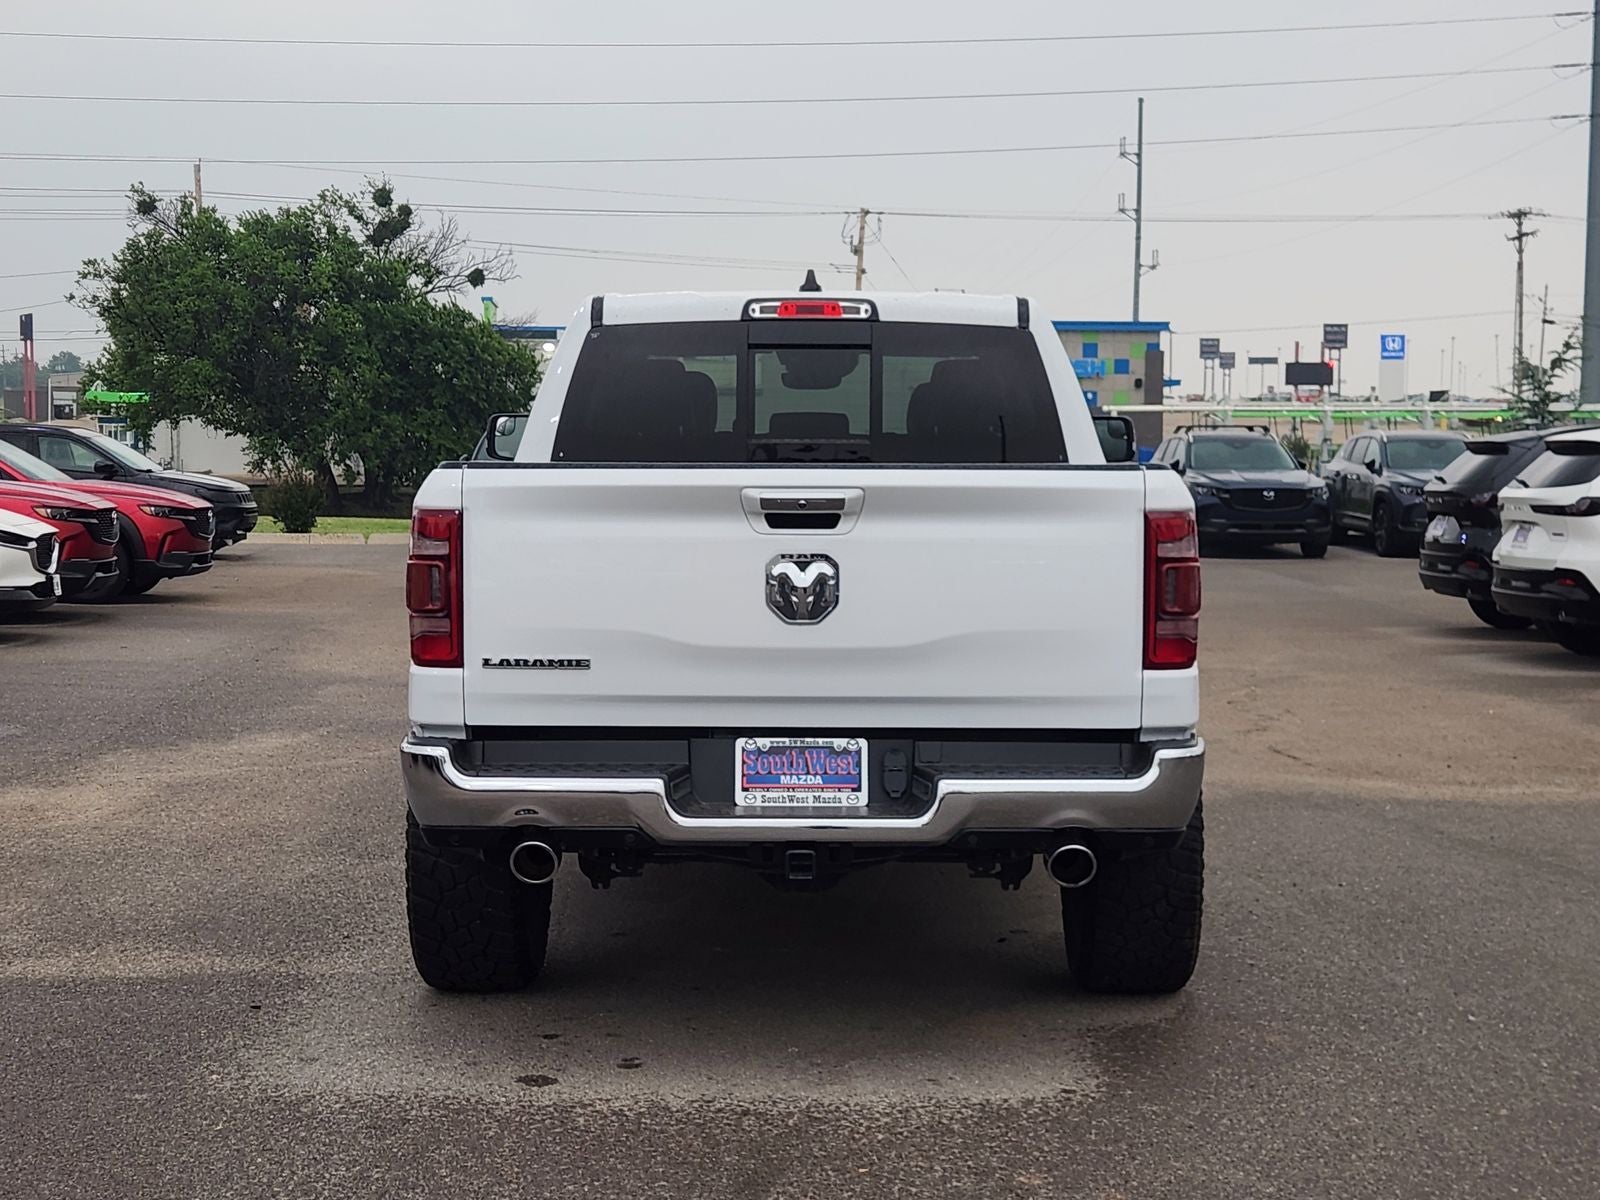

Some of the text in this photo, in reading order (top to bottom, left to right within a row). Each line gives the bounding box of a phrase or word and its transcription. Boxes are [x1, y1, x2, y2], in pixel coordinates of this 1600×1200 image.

[482, 658, 590, 670] LARAMIE
[743, 748, 860, 775] SouthWest
[780, 775, 823, 785] MAZDA
[761, 794, 842, 804] SouthWest Mazda
